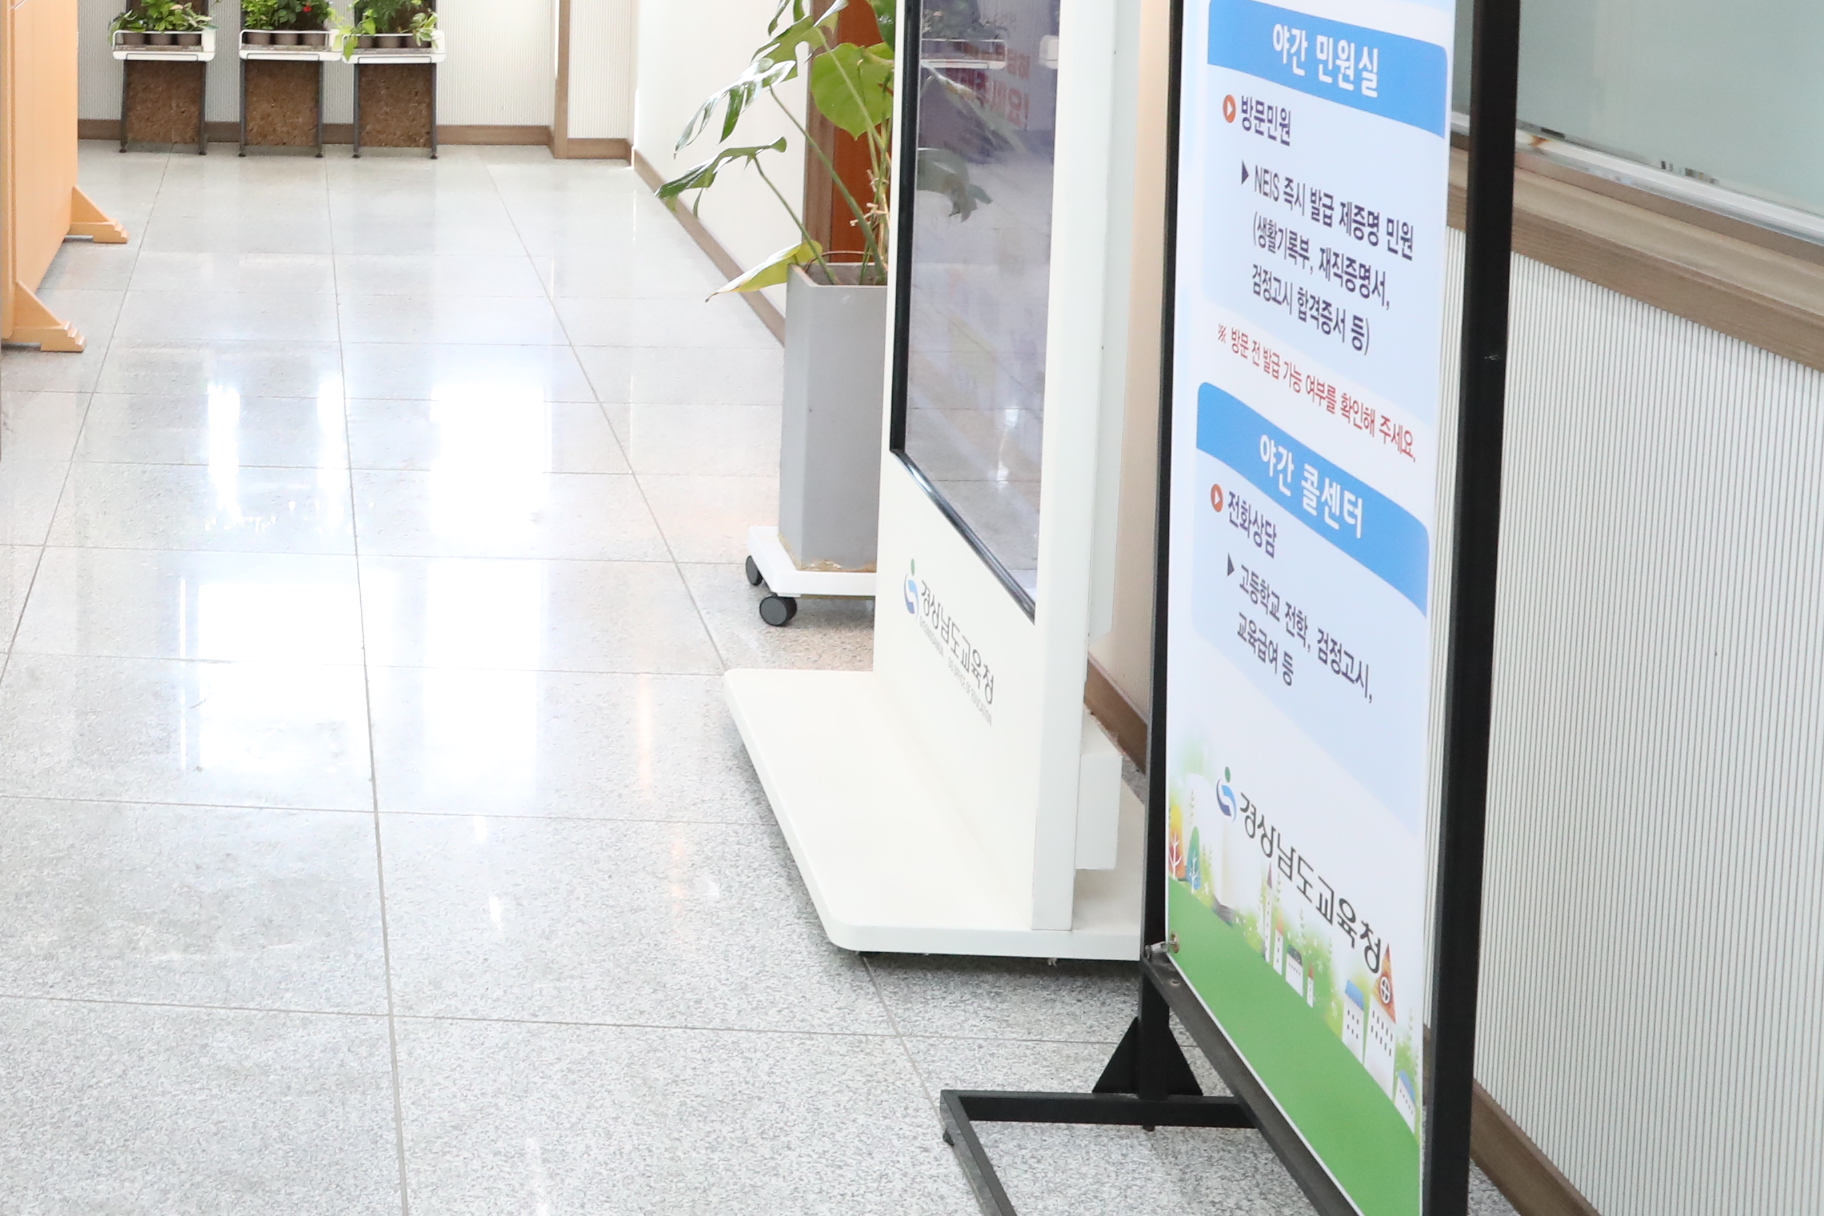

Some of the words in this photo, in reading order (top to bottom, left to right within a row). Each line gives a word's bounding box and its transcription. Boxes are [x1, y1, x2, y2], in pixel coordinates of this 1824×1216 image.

[1271, 23, 1309, 78] 야간
[1315, 35, 1379, 99] 민원실
[1240, 95, 1292, 147] 방문민원
[1253, 211, 1314, 275] (생활기록부,
[1254, 164, 1281, 203] NEIS
[1283, 176, 1306, 217] 즉시
[1310, 187, 1335, 229] 발급
[1338, 201, 1381, 247] 제증명
[1386, 216, 1414, 262] 민원
[1252, 263, 1293, 316] 검정고시
[1297, 286, 1347, 344] 합격증서
[1350, 314, 1371, 357] 등)
[1231, 327, 1250, 360] 방문
[1251, 339, 1262, 368] 전
[1262, 345, 1282, 381] 발급
[1283, 360, 1303, 394] 가능
[1306, 374, 1338, 415] 여부를
[1340, 392, 1376, 439] 확인해
[1227, 489, 1278, 560] 전화상담
[1259, 433, 1296, 498] 야간
[1301, 462, 1364, 539] 콜센터
[1238, 563, 1282, 623] 고등학교
[921, 579, 995, 706] 경상남도교육청
[1237, 611, 1278, 676] 교육급여
[1281, 650, 1295, 687] 등
[1239, 792, 1382, 975] 경상남도교육청
